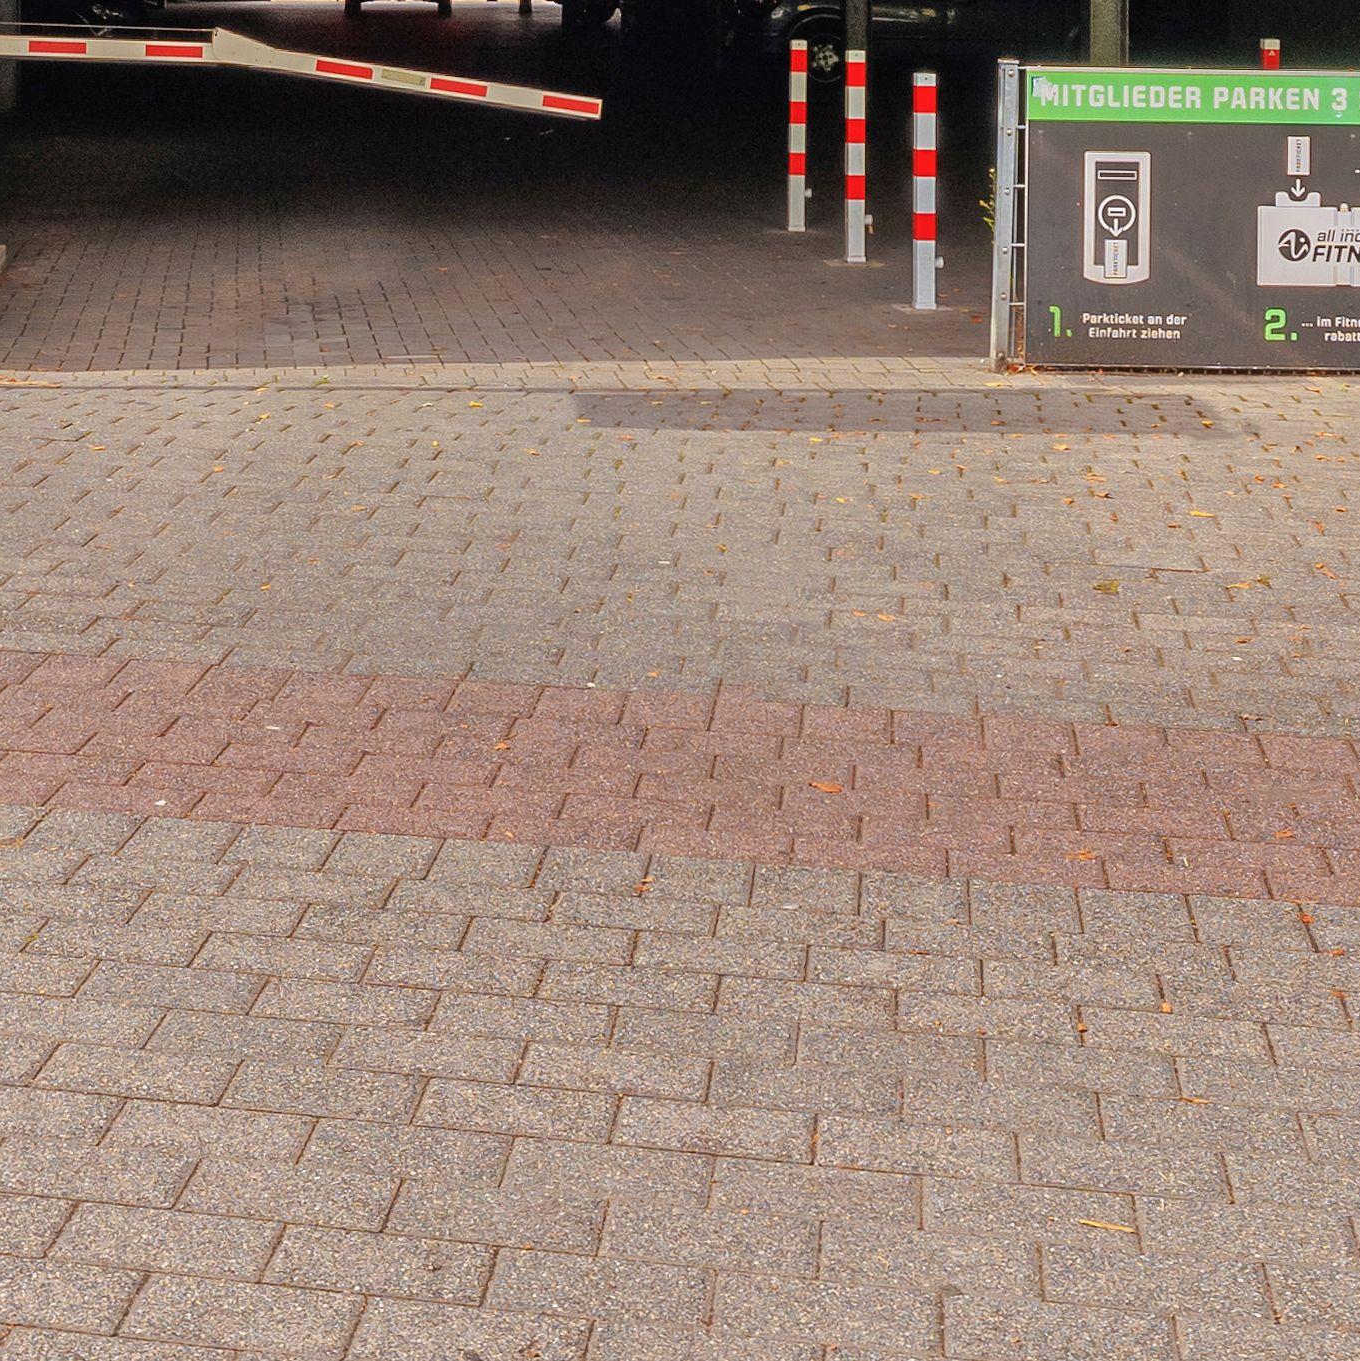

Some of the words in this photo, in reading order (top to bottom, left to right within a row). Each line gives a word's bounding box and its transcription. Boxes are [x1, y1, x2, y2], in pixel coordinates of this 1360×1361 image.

[1041, 84, 1202, 108] MITGLIEDER
[1213, 86, 1320, 111] PARKEN
[1331, 87, 1348, 111] 3
[1317, 229, 1335, 242] all
[1049, 305, 1073, 338] 1.
[1082, 313, 1144, 326] Parkticket
[1147, 315, 1163, 326] an
[1166, 313, 1187, 326] der
[1264, 308, 1299, 341] 2.
[1317, 315, 1332, 328] im
[1088, 327, 1137, 338] Einfahrt
[1140, 328, 1180, 339] ziehen
